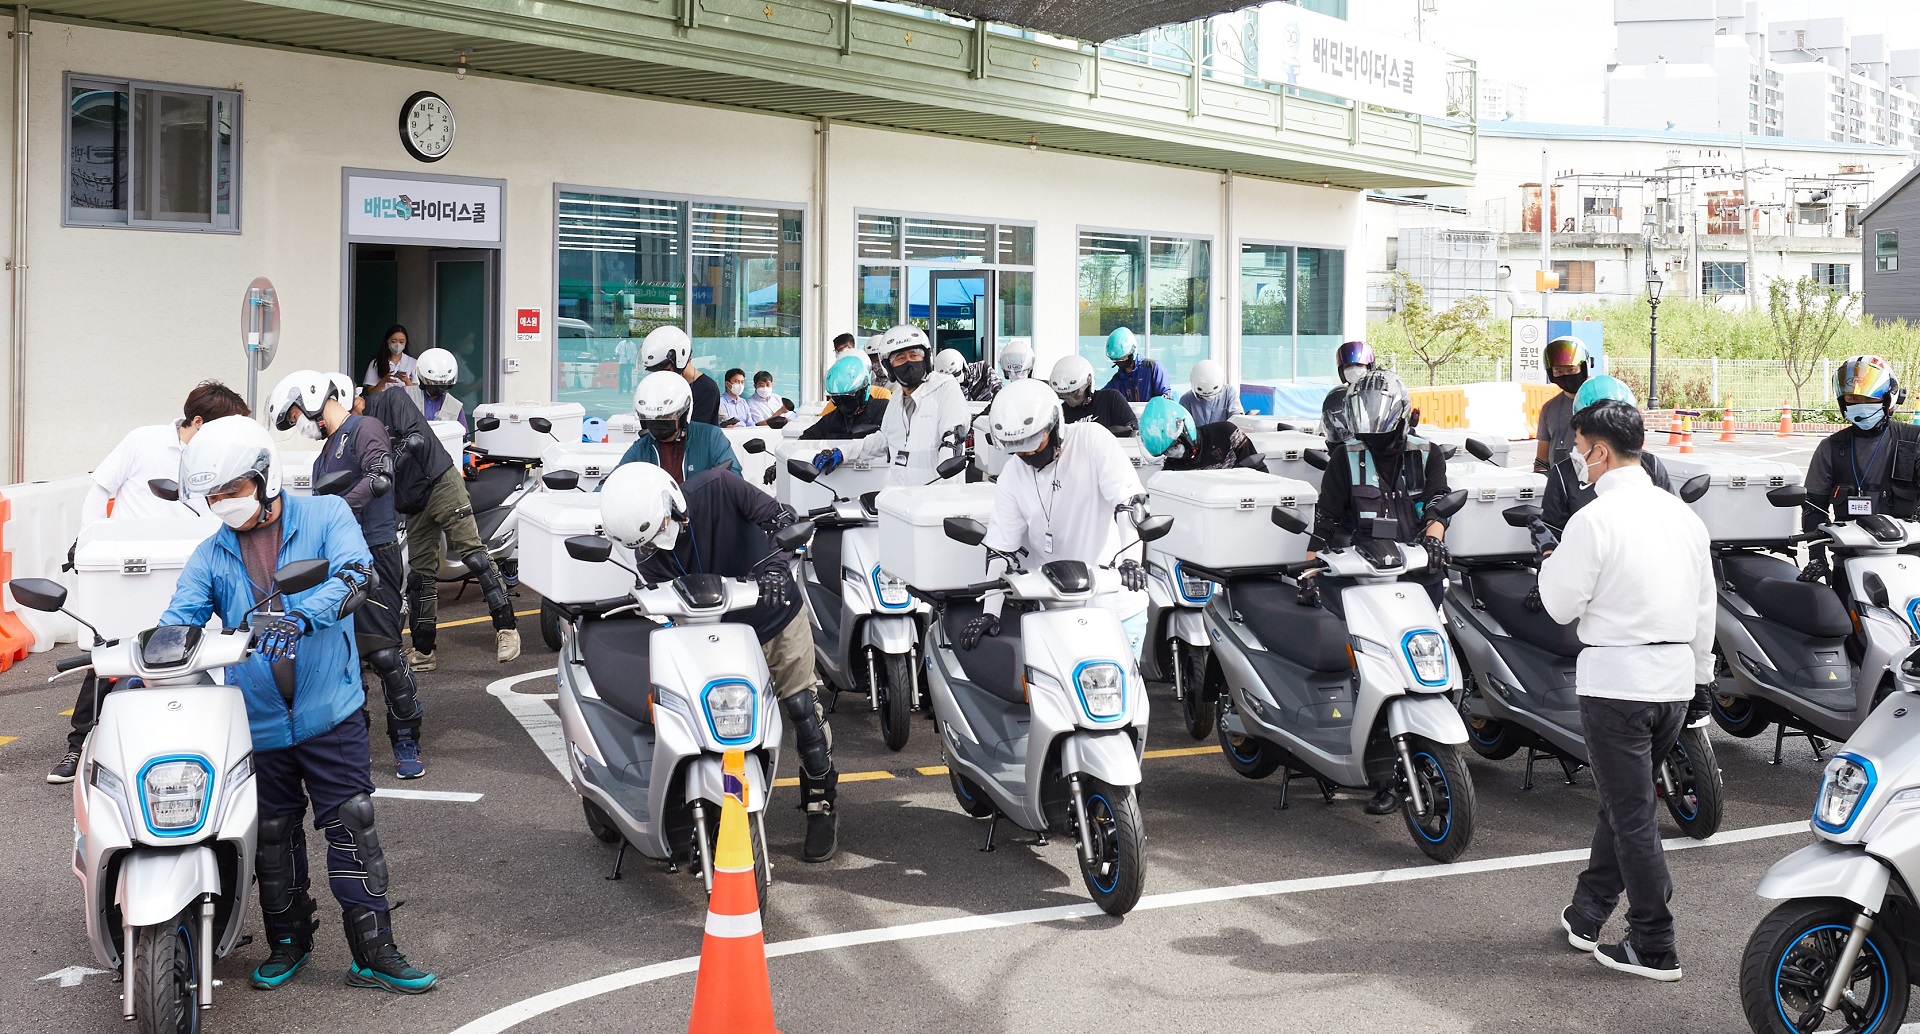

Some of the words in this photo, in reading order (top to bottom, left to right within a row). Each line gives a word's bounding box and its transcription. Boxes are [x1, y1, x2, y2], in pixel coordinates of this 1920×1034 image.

[1313, 37, 1414, 94] 배민라이더스쿨
[427, 143, 432, 151] 6
[364, 197, 397, 218] 배민
[411, 200, 486, 223] 라이더스쿨
[520, 317, 537, 326] 에스원
[1520, 346, 1539, 358] 흡연
[1520, 359, 1539, 370] 구역
[191, 474, 212, 483] HJC
